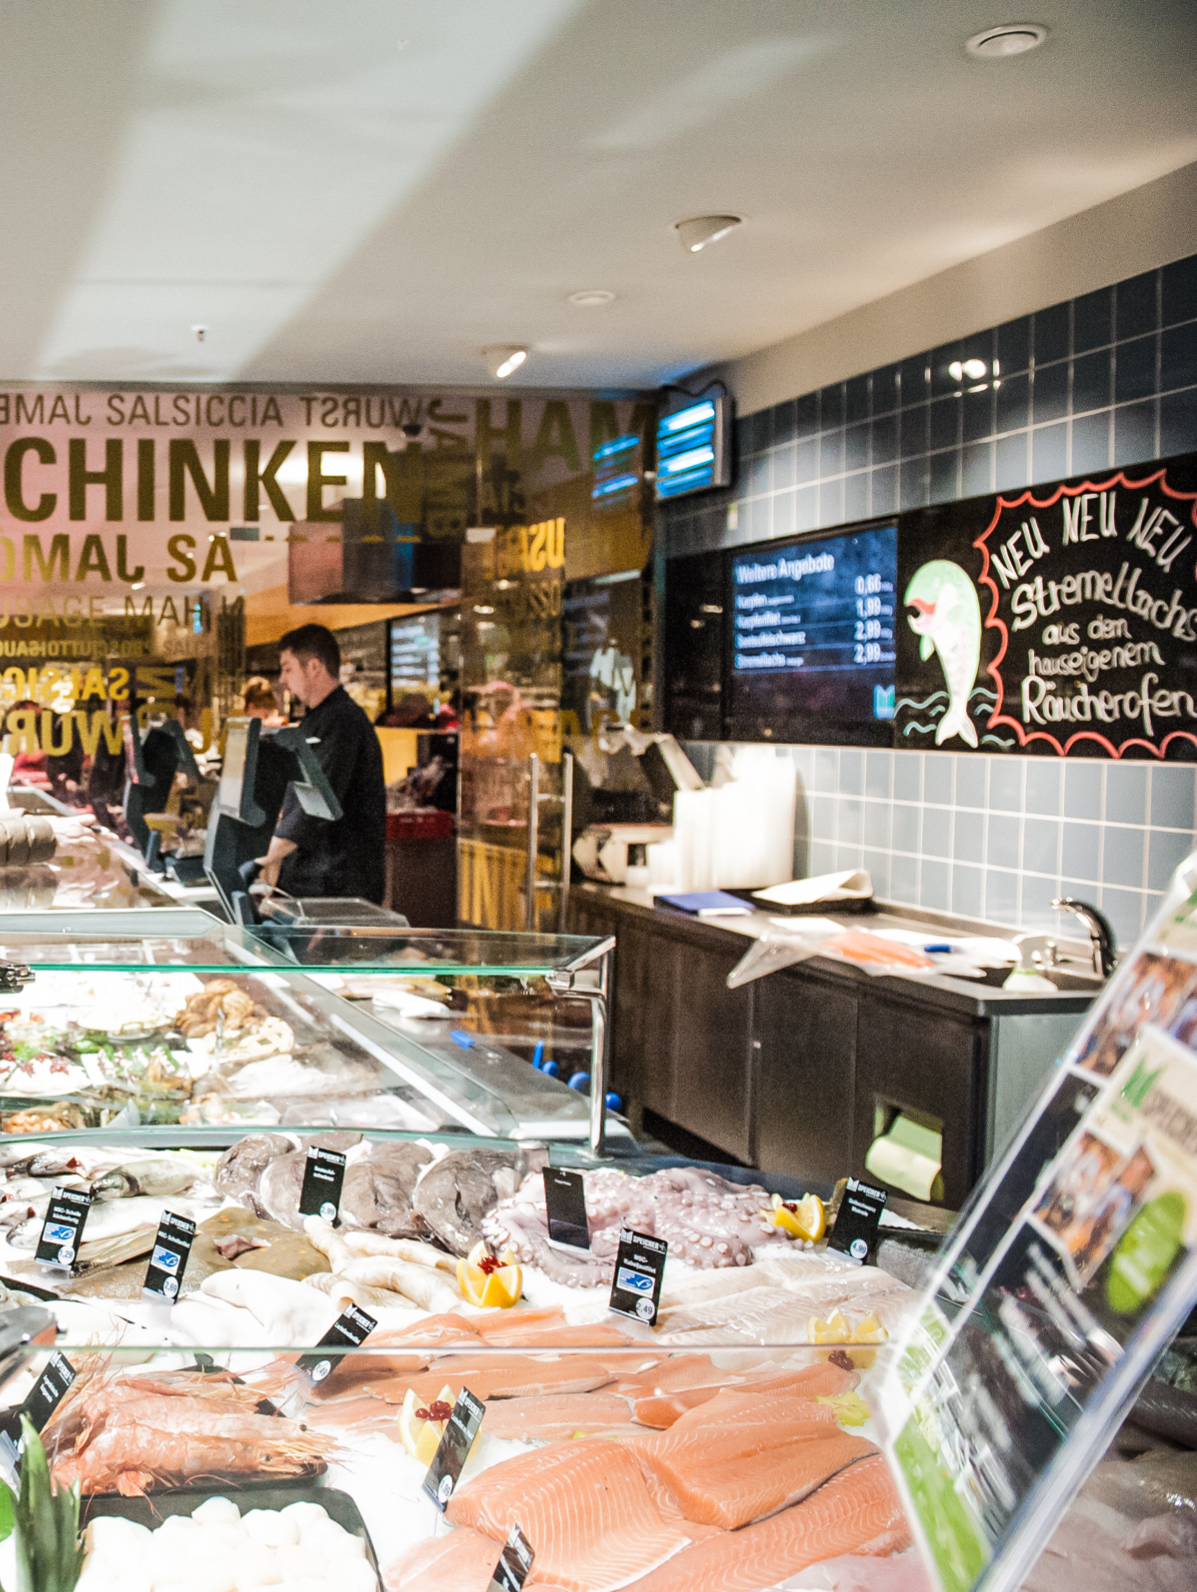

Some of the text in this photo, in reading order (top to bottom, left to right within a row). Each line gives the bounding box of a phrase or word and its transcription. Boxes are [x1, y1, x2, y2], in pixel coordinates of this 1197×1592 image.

[106, 394, 284, 427] SALSICCIA
[991, 491, 1193, 589] NEU NEU NEU
[735, 552, 835, 585] Weitere Angebote
[1011, 562, 1197, 642] Stremellachs
[1042, 622, 1081, 646] aus
[1028, 641, 1166, 683] hauseigenem
[1021, 672, 1197, 737] Räucherofen
[632, 1235, 660, 1250] SPEICHER
[852, 1242, 867, 1254] 4,99
[636, 1302, 654, 1315] 2,49
